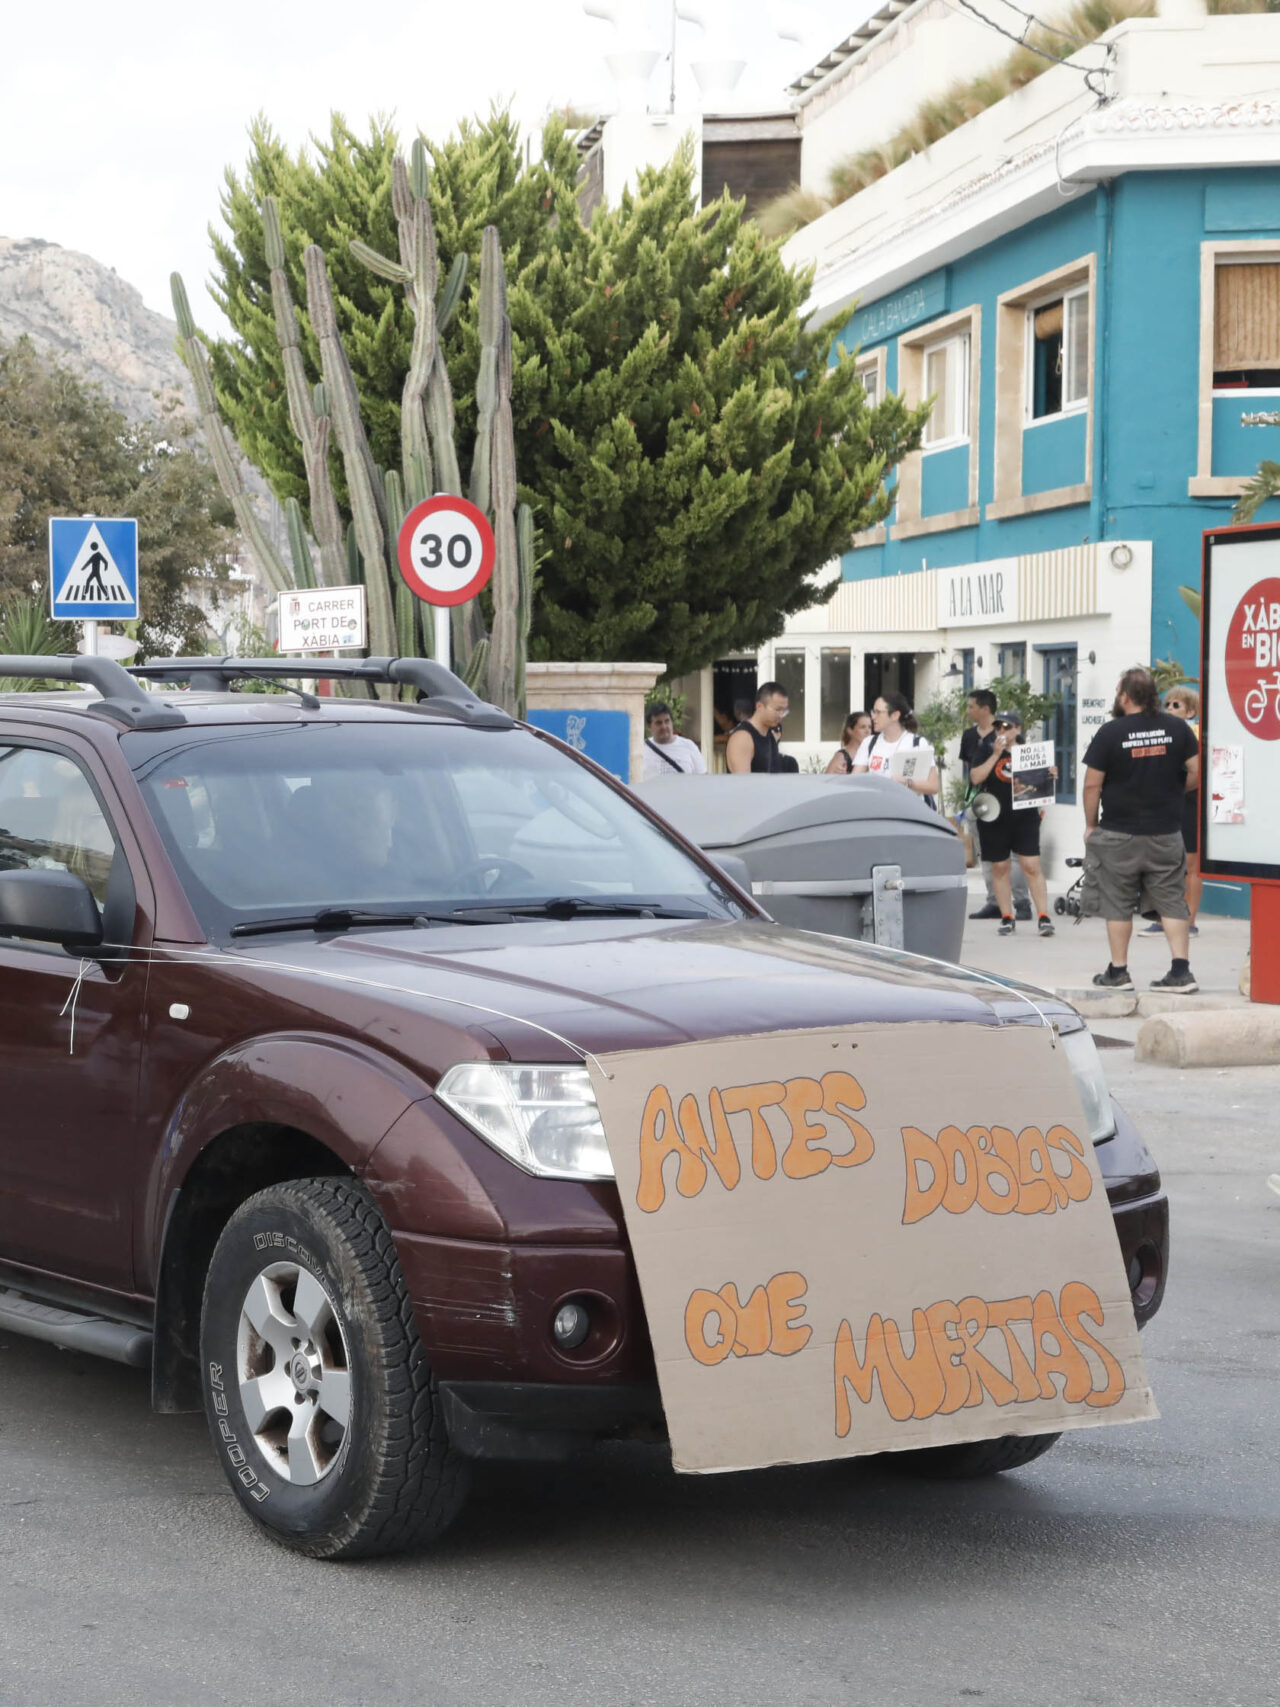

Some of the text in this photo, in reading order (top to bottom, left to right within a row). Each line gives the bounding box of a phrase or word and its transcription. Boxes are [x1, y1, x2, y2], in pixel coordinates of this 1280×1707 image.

[420, 533, 472, 569] 30
[308, 599, 355, 613] CARRER
[977, 572, 1005, 615] MAR
[302, 632, 340, 648] XÀBIA
[331, 616, 348, 628] DE
[1242, 632, 1280, 668] EN BI
[1020, 746, 1032, 754] NO
[1020, 753, 1041, 762] BOUS
[1030, 759, 1047, 768] MAR
[636, 1070, 876, 1214] ANTES
[684, 1271, 813, 1366] QUE
[833, 1281, 1126, 1438] MUERTAS
[208, 1361, 271, 1504] COOPER
